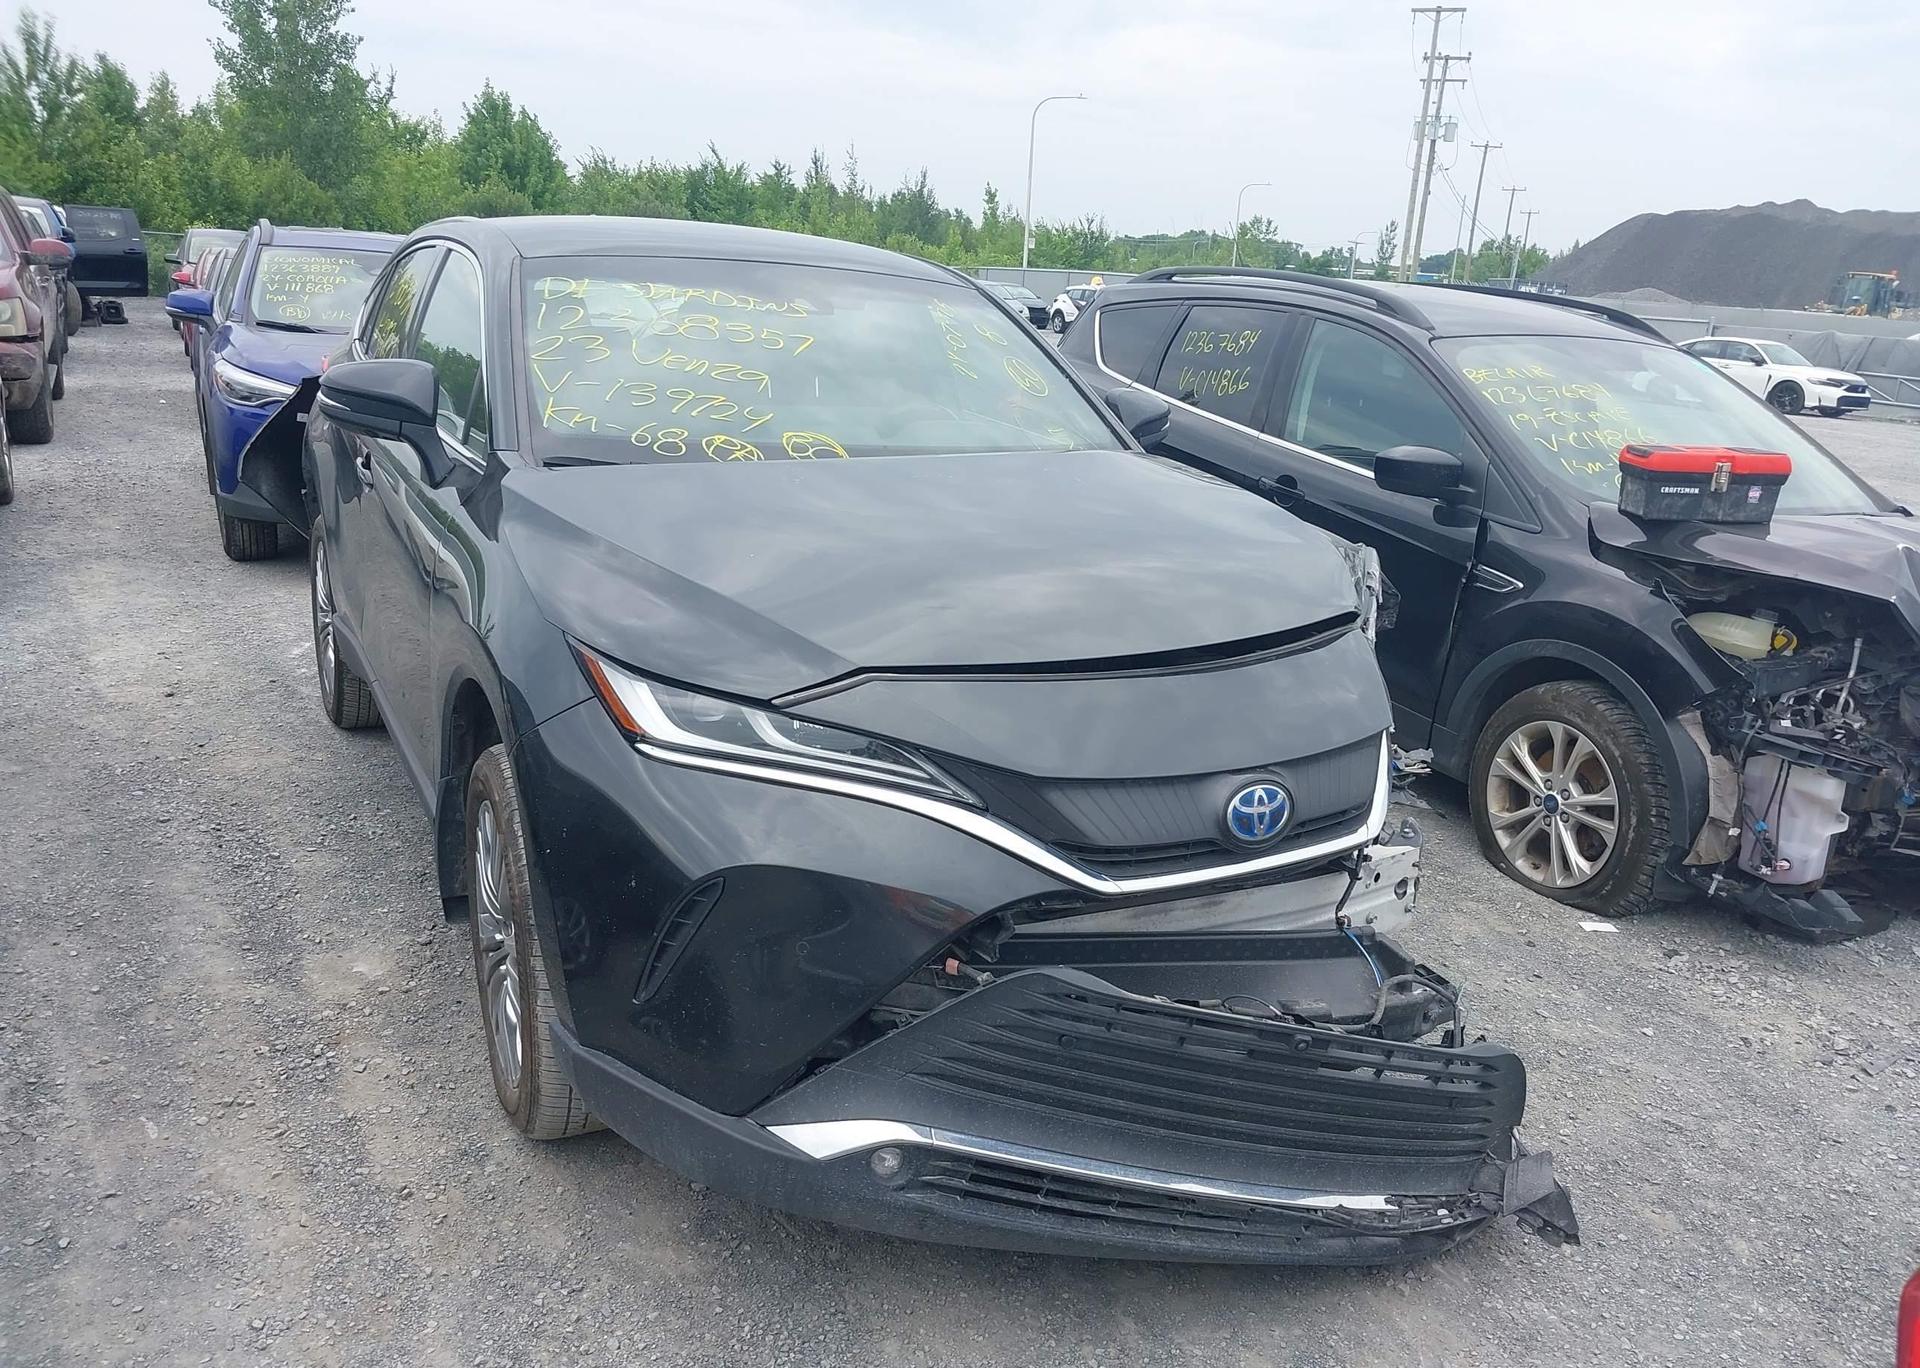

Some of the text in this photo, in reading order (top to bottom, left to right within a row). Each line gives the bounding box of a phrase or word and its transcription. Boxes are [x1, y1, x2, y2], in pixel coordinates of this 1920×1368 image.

[531, 335, 611, 363] 23
[1181, 329, 1262, 356] 12367684
[1660, 486, 1699, 495] CRAFTSMAN
